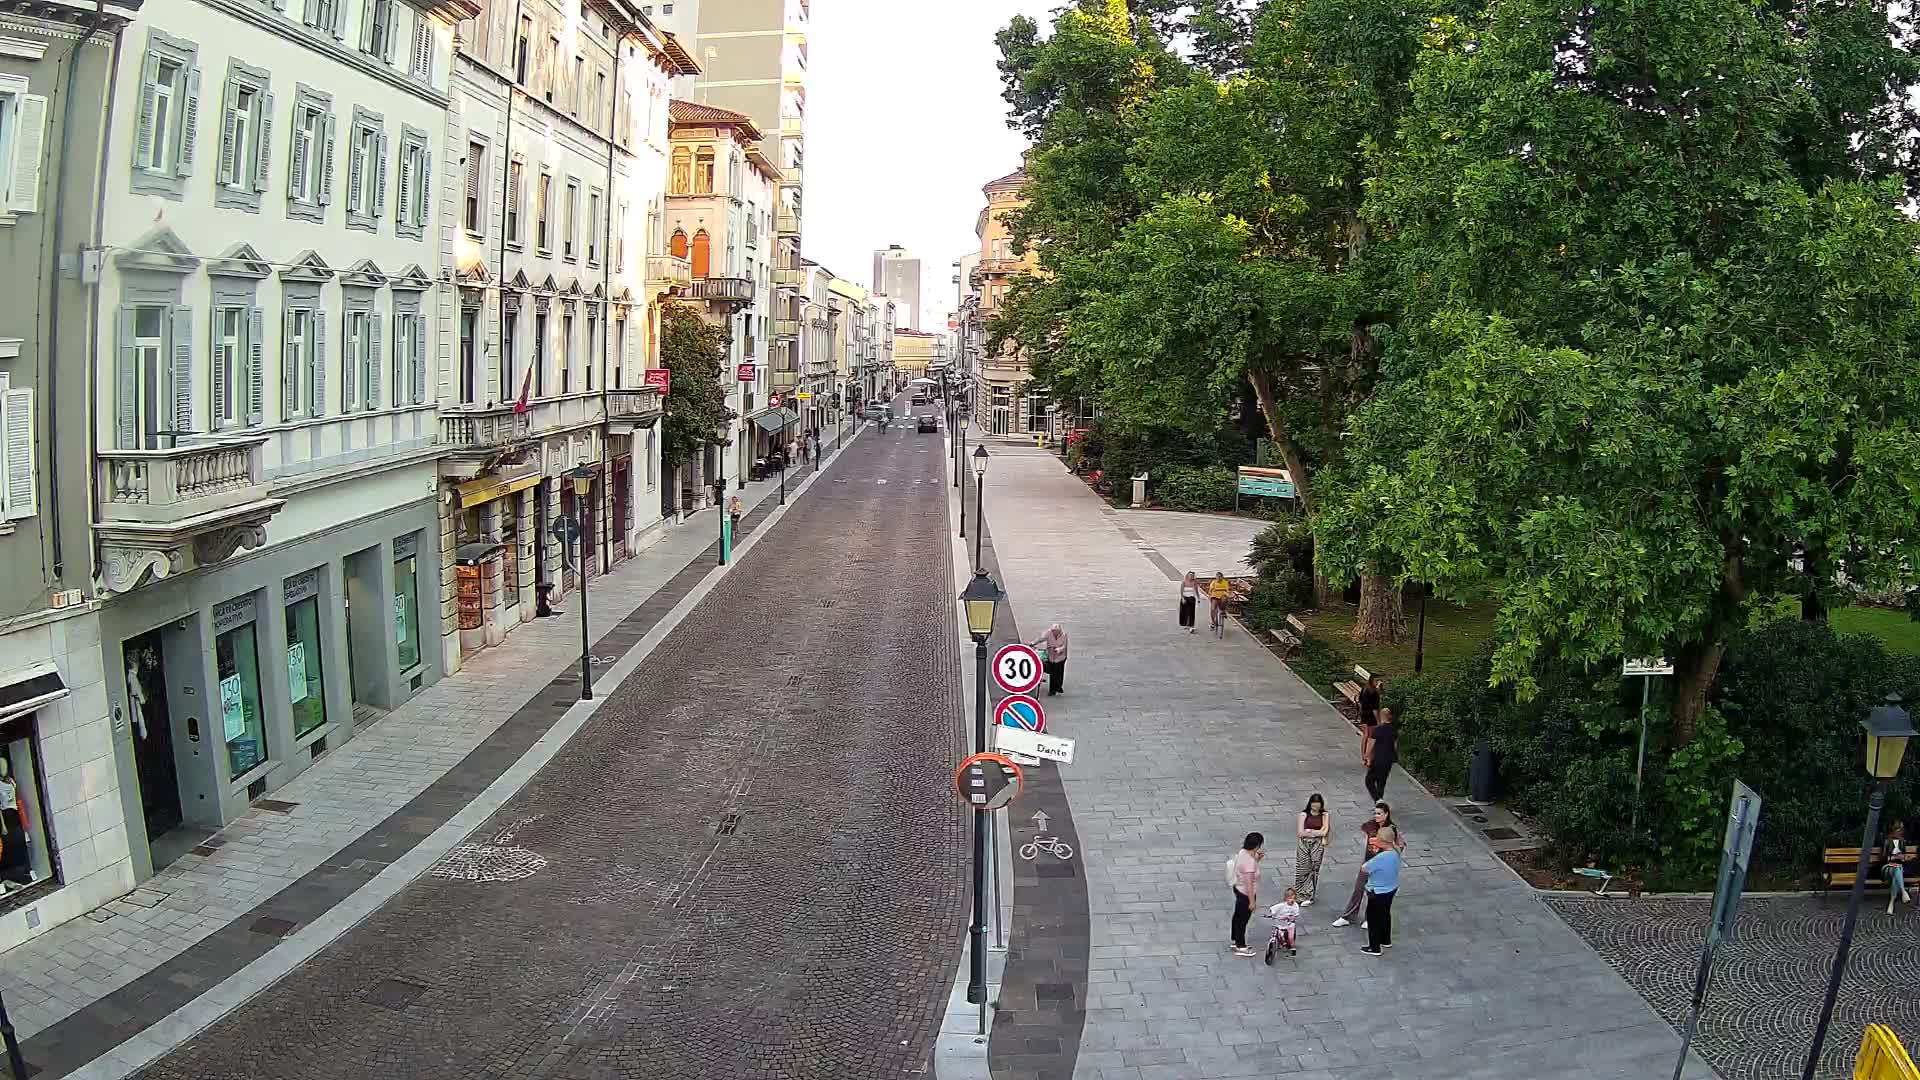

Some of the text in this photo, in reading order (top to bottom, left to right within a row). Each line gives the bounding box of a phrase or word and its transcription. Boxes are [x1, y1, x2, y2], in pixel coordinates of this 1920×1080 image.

[1004, 658, 1032, 680] 30
[221, 678, 239, 700] 130
[1037, 743, 1067, 757] Dante
